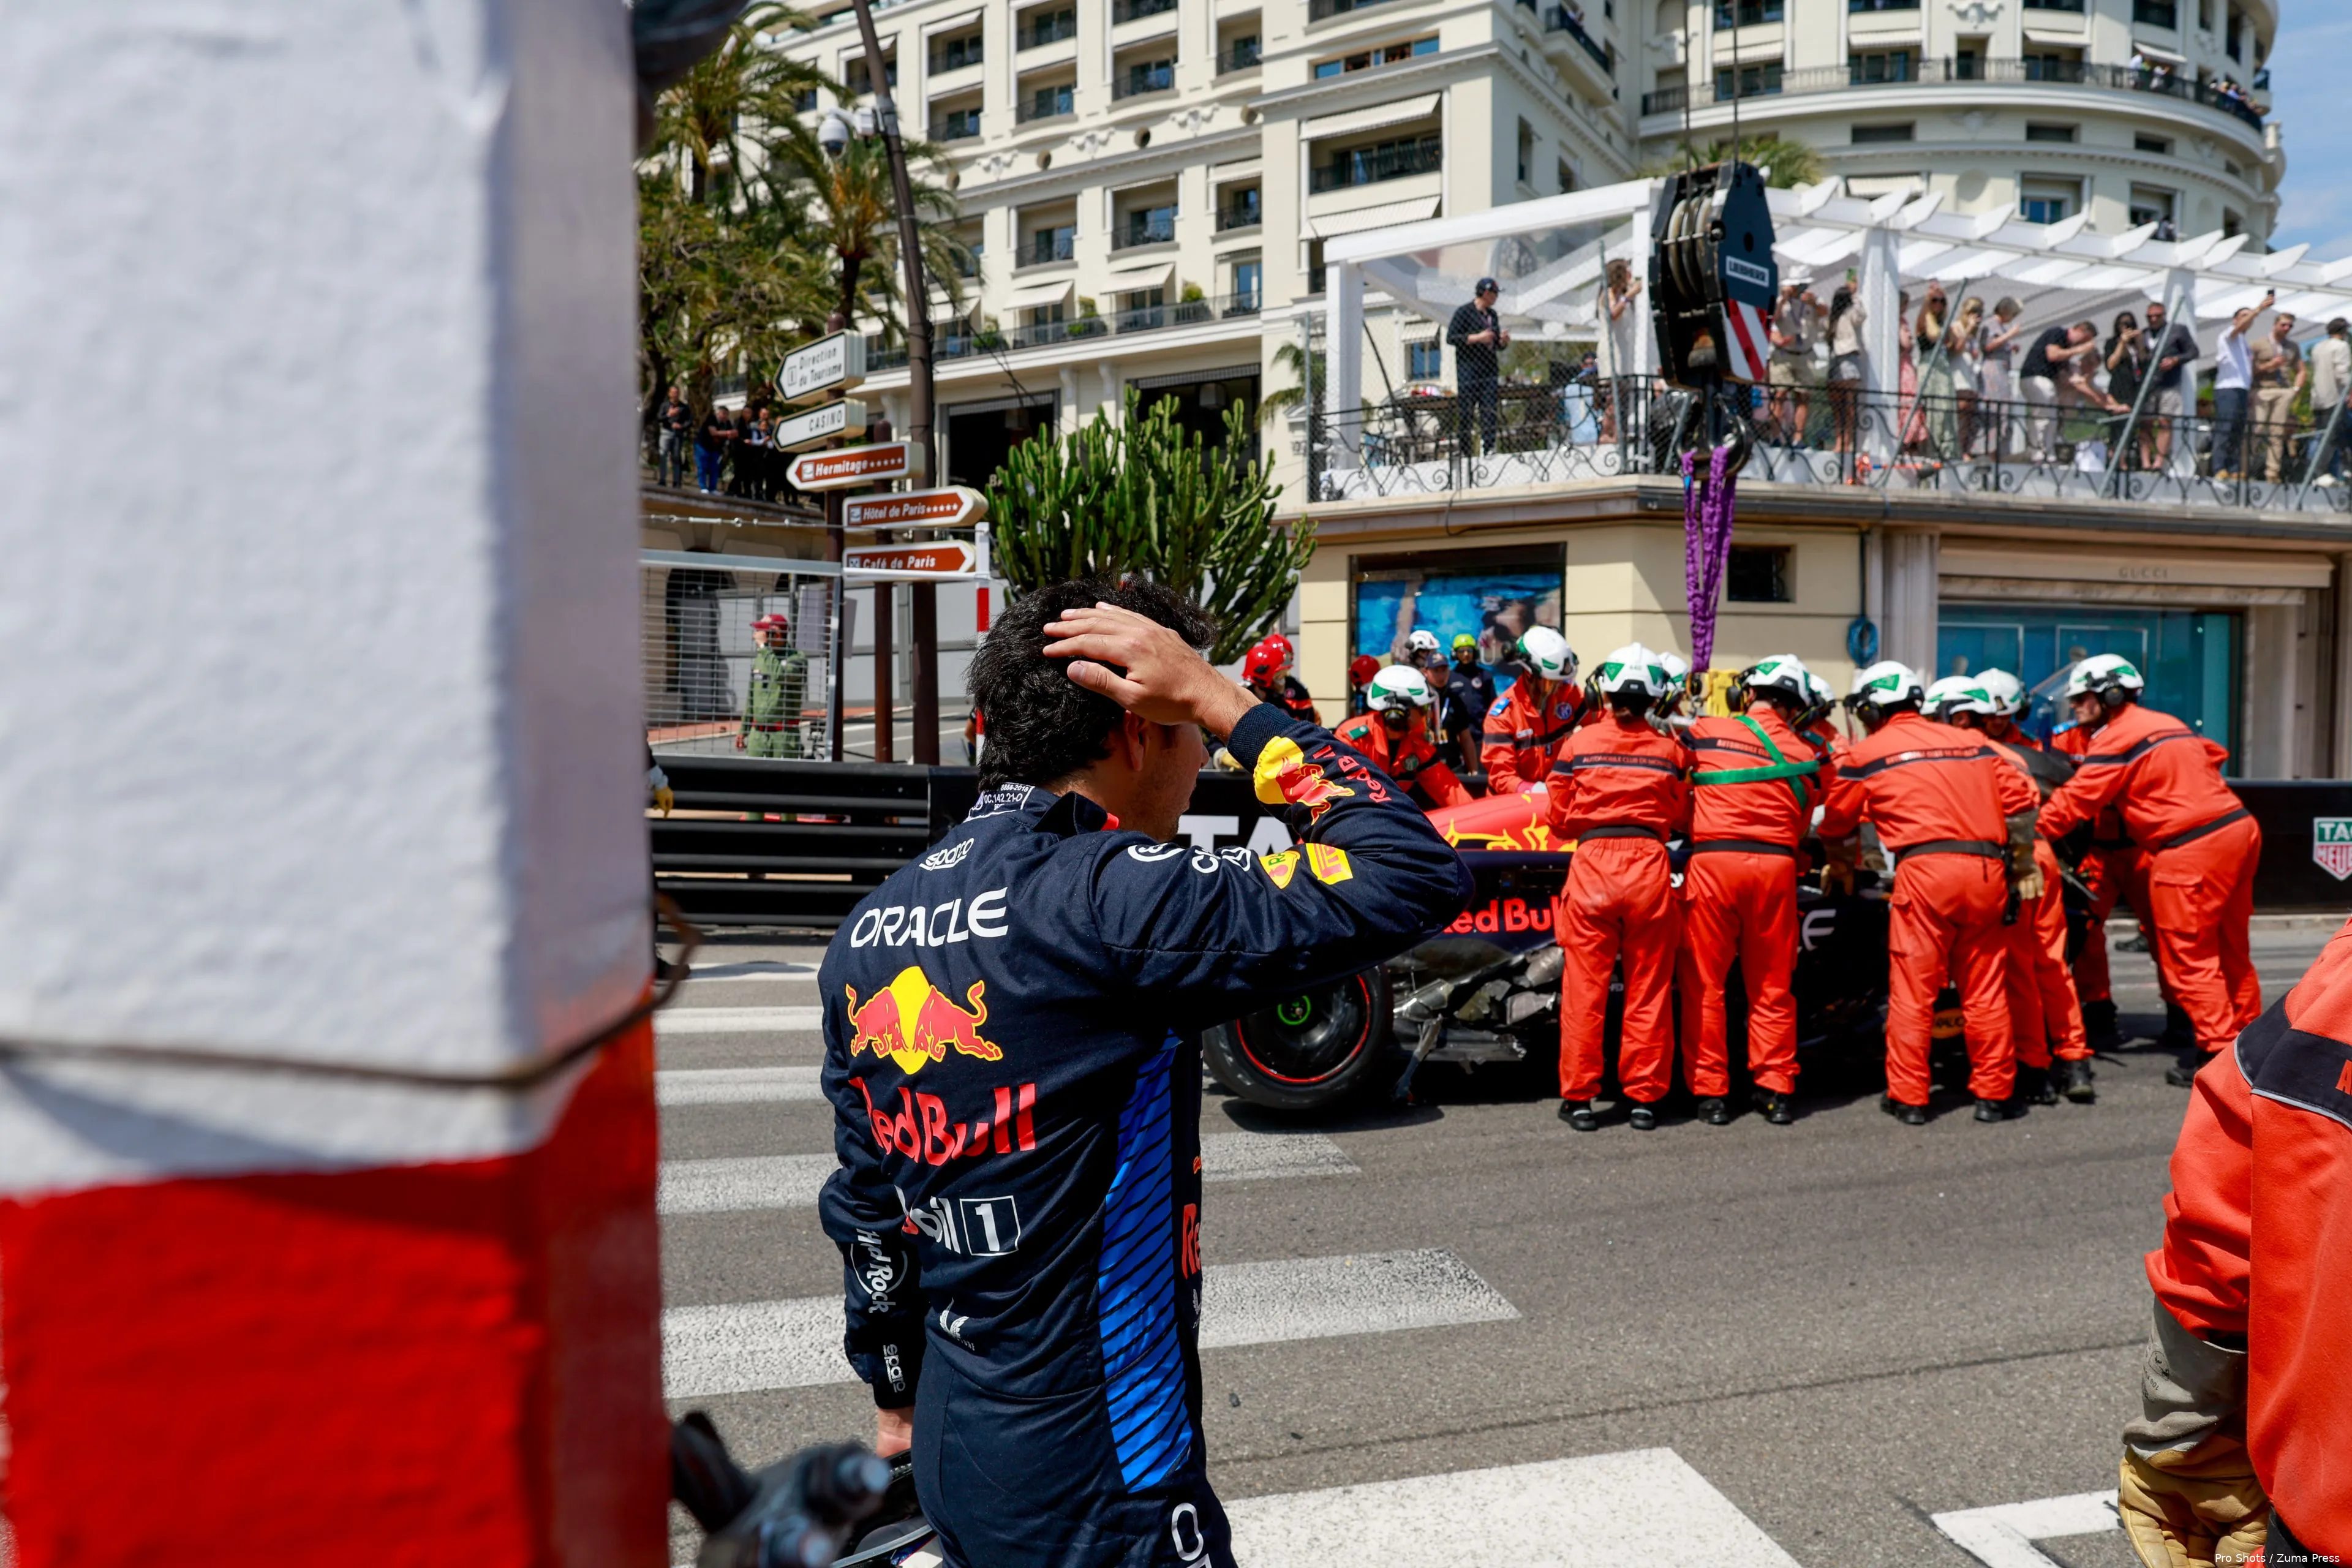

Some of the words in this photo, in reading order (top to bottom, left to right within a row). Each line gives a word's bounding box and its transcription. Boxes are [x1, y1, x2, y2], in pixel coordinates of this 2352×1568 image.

[799, 347, 837, 369] Direction
[799, 375, 808, 388] du
[810, 363, 842, 383] Tourisme
[809, 410, 843, 432] CASINO
[815, 459, 867, 476] Hermitage
[863, 506, 886, 520] Hôtel
[889, 504, 899, 517] de
[902, 502, 925, 516] Paris
[862, 557, 886, 568] Café
[891, 556, 903, 568] de
[907, 556, 936, 568] Paris
[2119, 565, 2168, 579] GUCCI
[851, 886, 1009, 948] ORACLE
[975, 1203, 1000, 1251] 1
[867, 1263, 897, 1314] Rock
